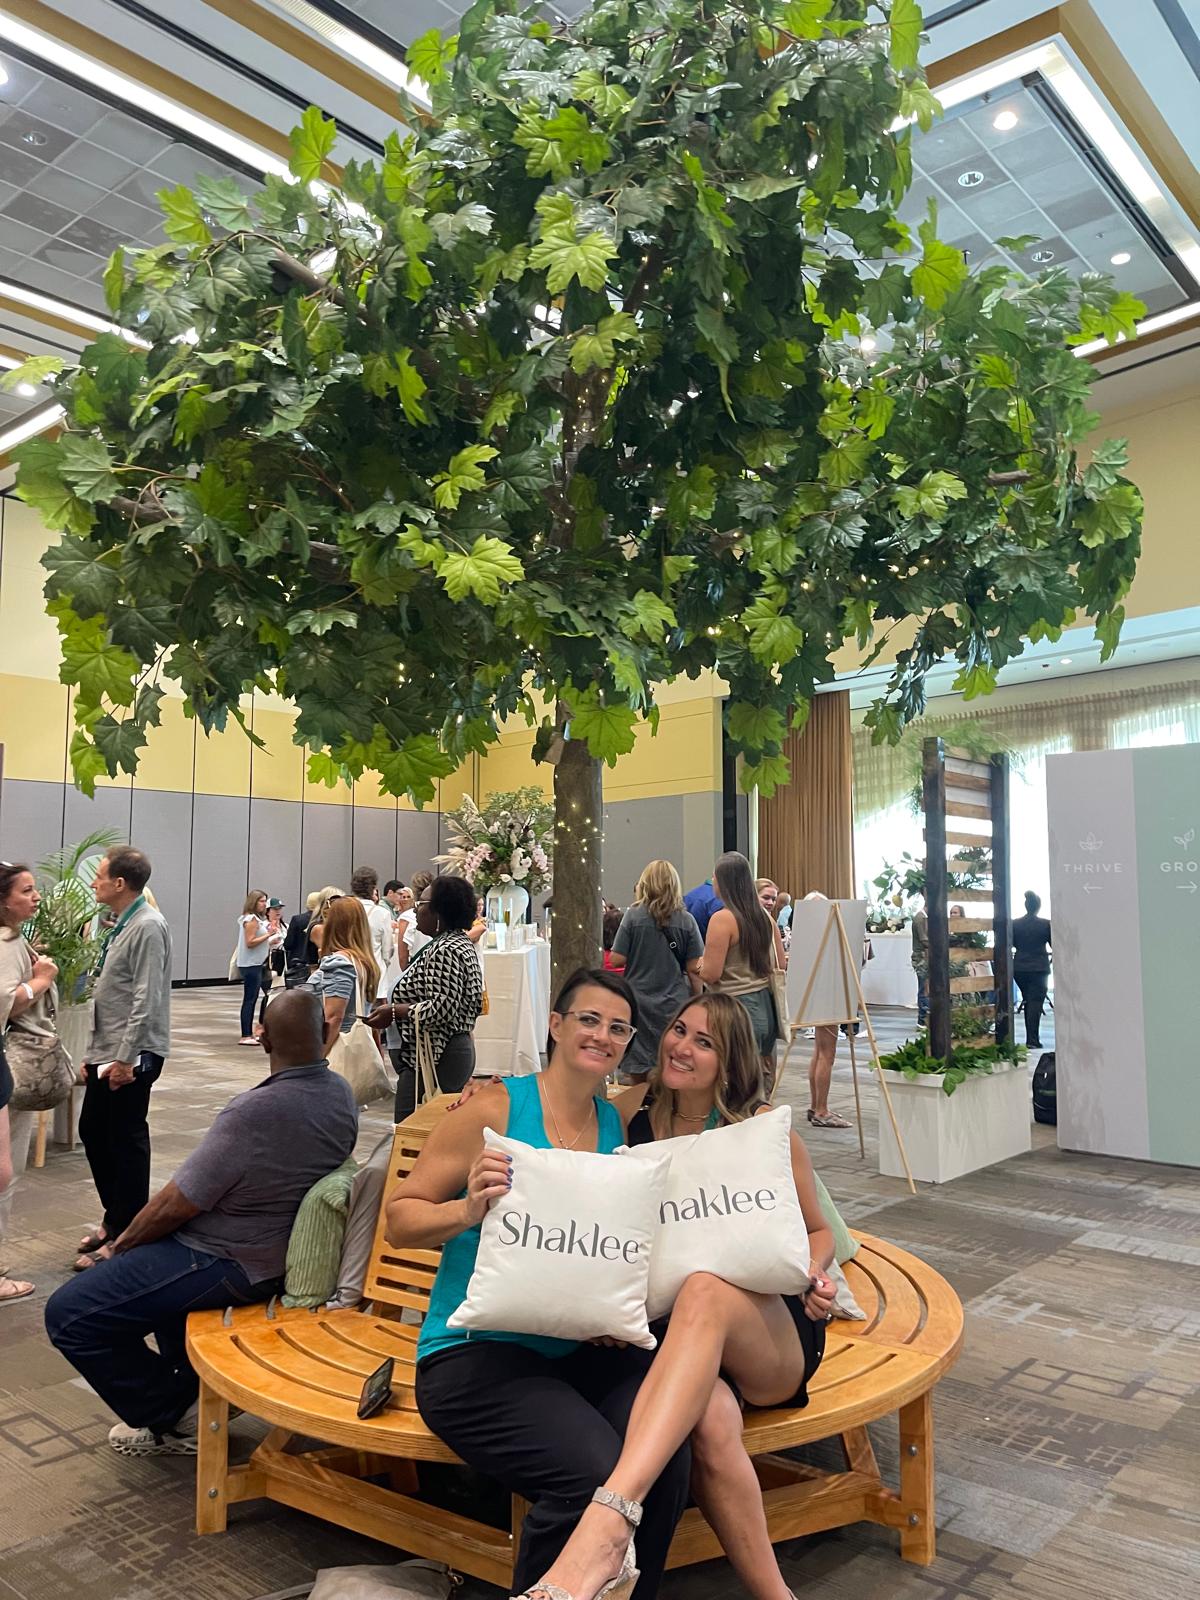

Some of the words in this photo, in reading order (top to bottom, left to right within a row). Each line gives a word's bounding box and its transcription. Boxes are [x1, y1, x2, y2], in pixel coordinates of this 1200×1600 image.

[1063, 863, 1123, 873] THRIVE
[1160, 861, 1198, 873] GRO
[498, 1211, 640, 1264] Shaklee
